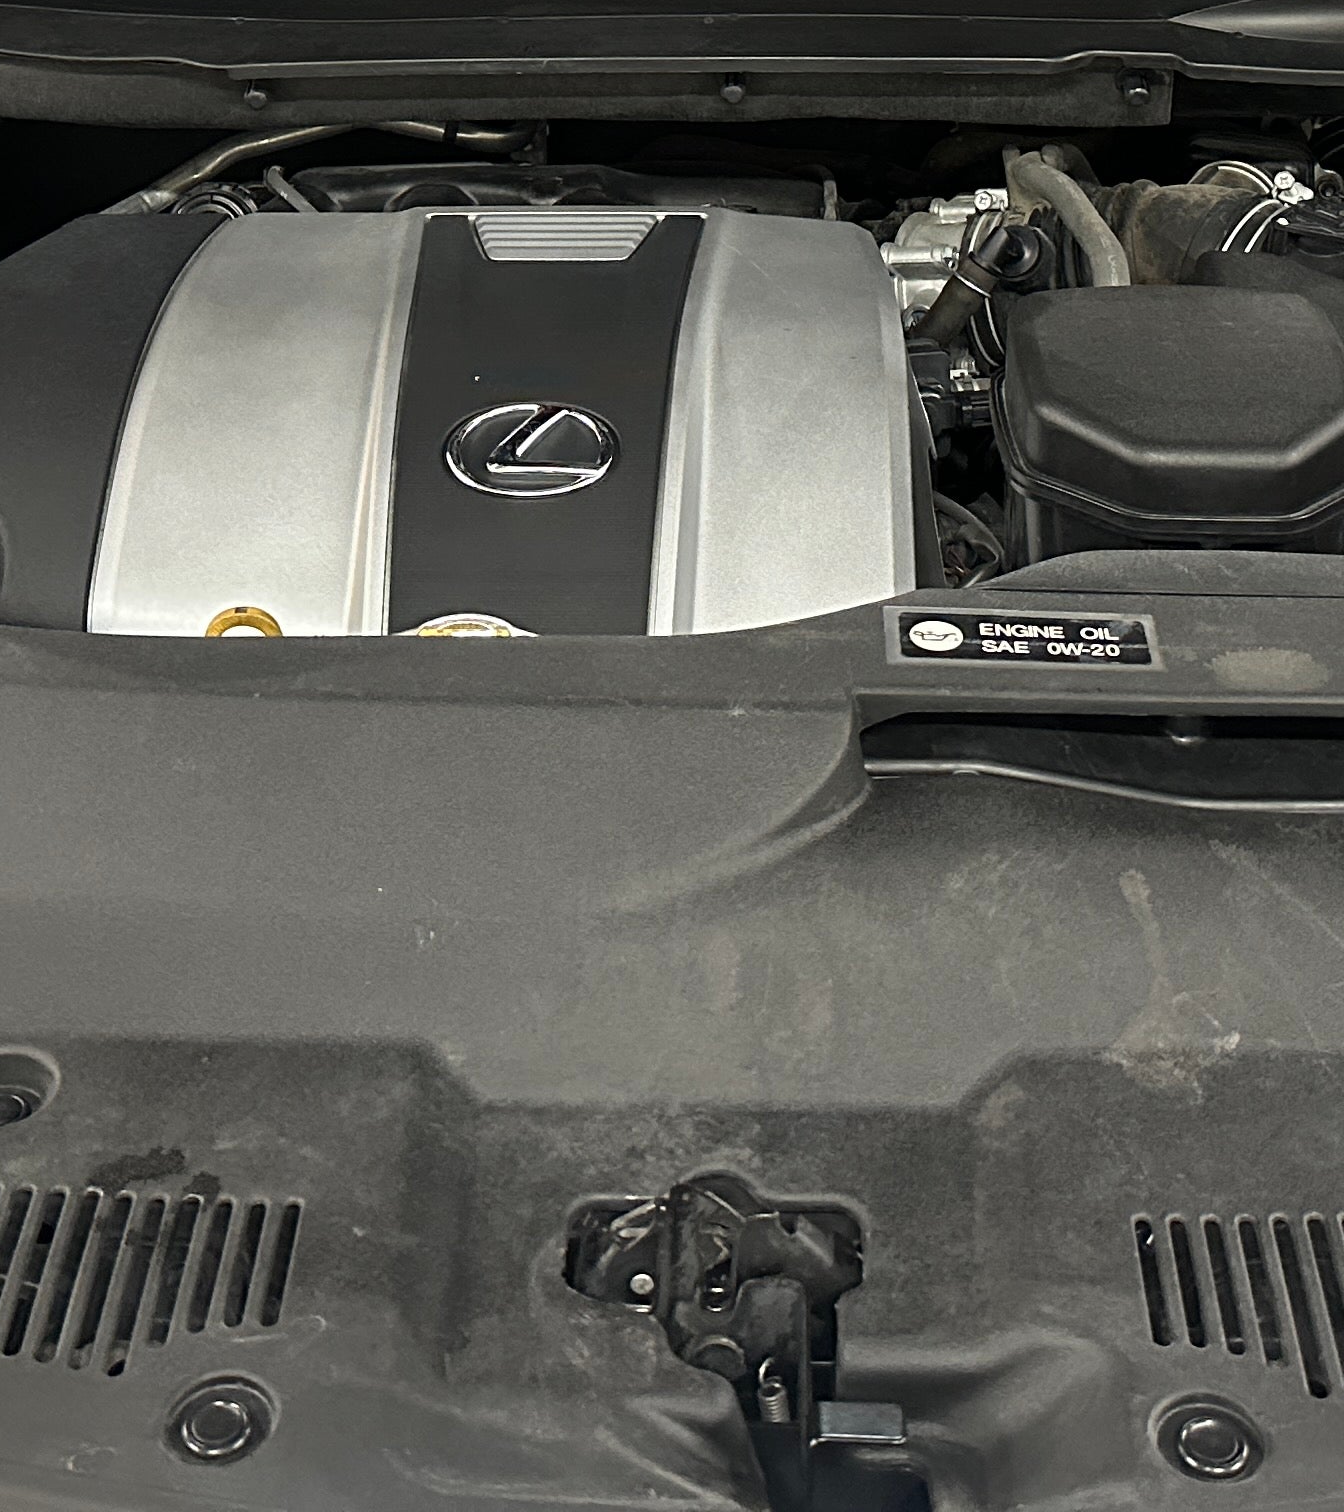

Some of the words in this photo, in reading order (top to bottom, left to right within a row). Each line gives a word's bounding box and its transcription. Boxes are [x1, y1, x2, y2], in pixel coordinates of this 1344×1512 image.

[978, 622, 1065, 640] ENGINE
[1079, 626, 1120, 641] OIL
[981, 639, 1031, 655] SAE
[1047, 642, 1121, 657] 0W-20
